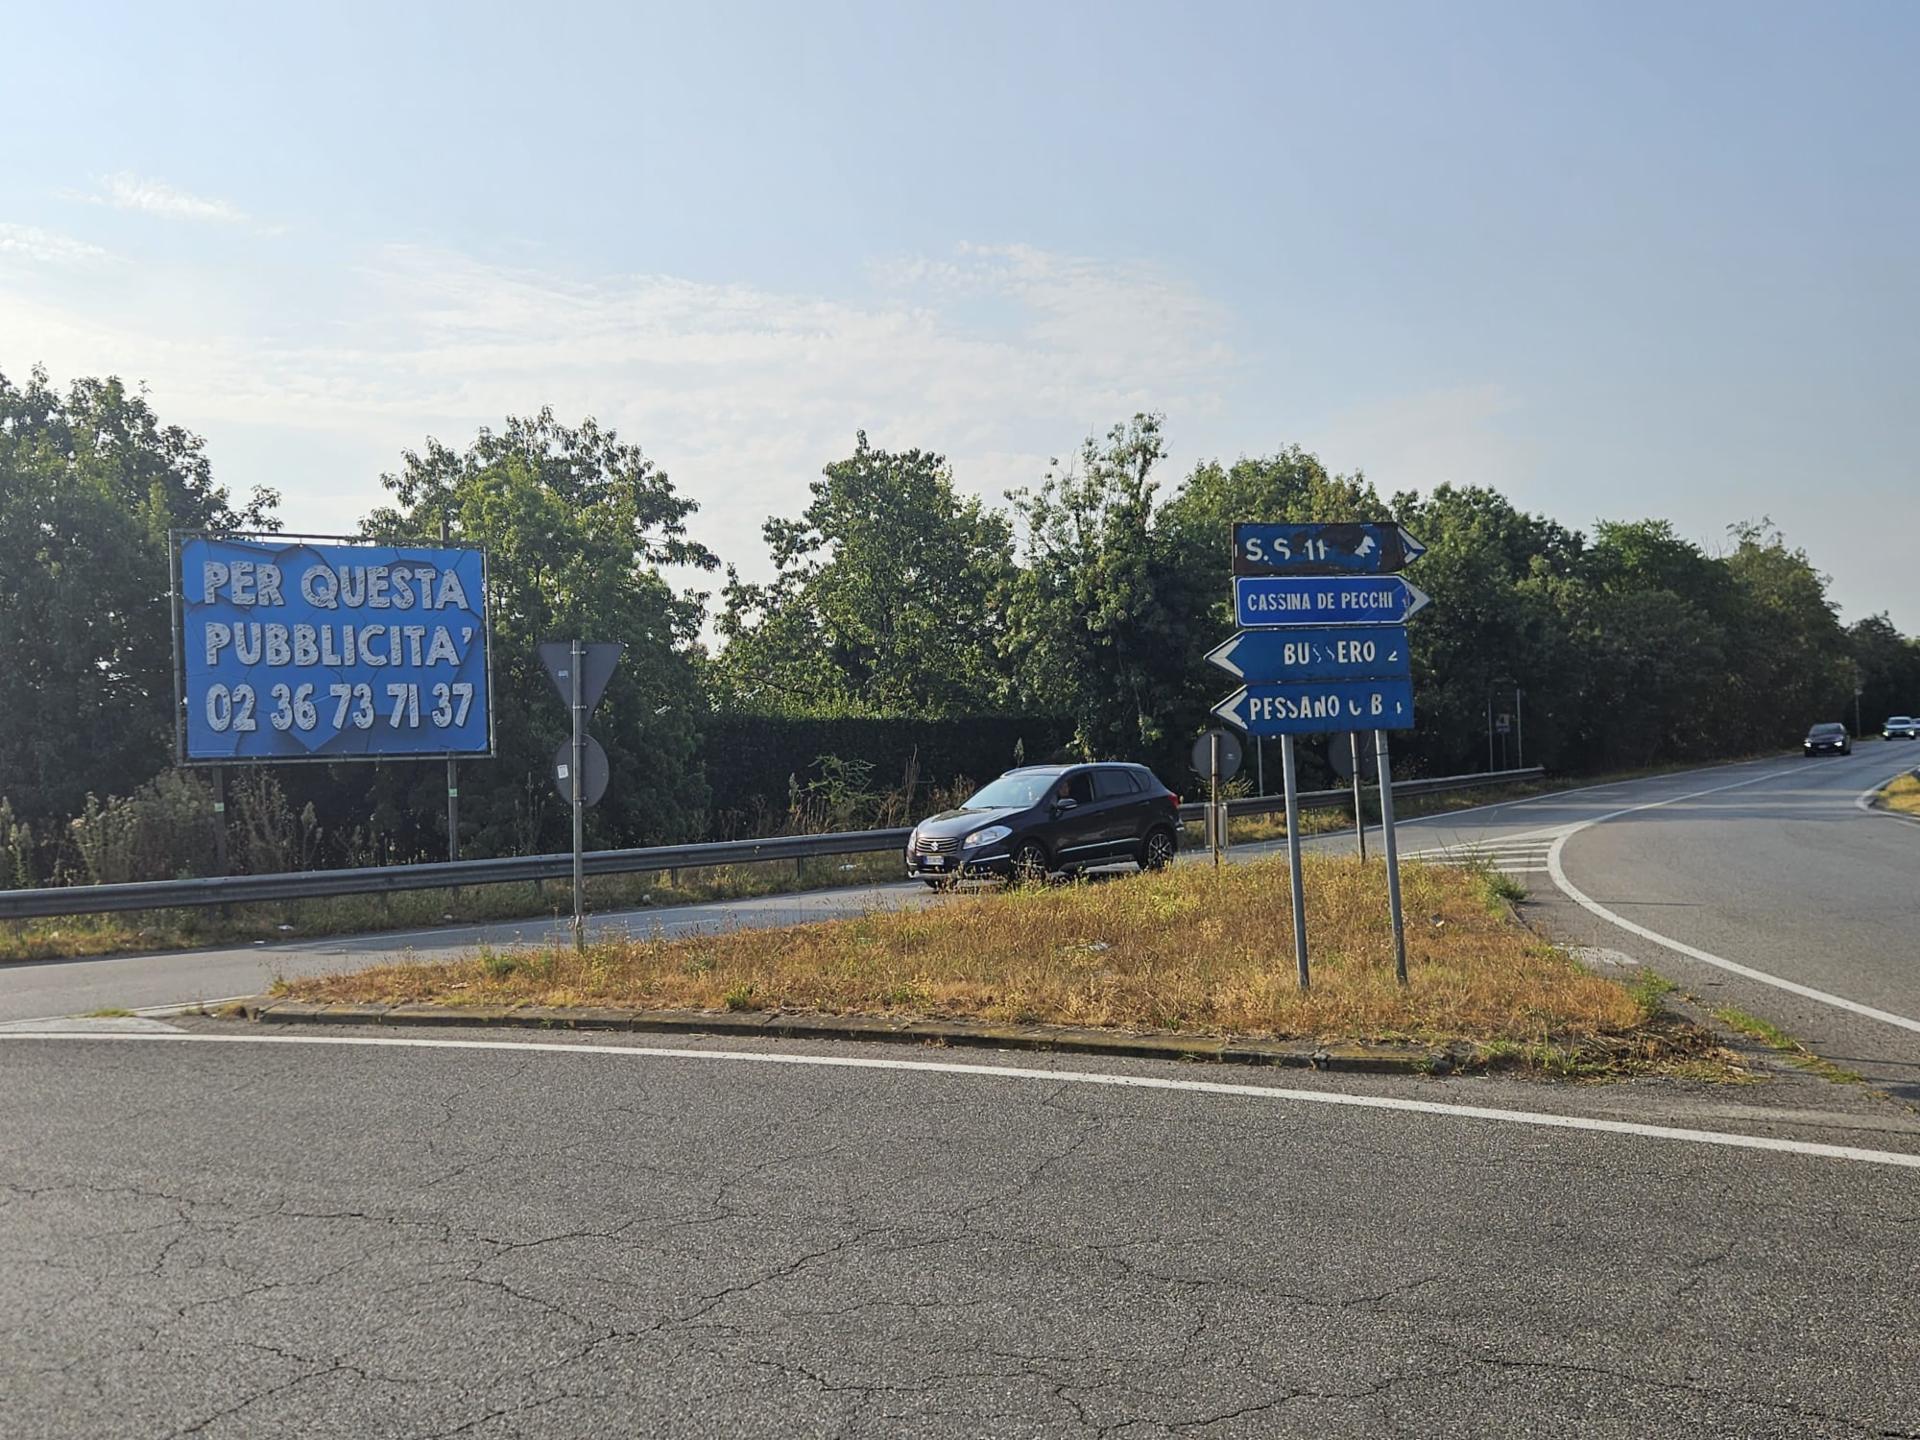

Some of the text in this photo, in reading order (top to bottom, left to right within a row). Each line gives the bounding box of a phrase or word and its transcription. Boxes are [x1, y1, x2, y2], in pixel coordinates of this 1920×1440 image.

[203, 561, 469, 610] PER QUESTA
[1247, 591, 1393, 611] CASSINA DE PECCHI
[205, 622, 472, 667] PUBBLICITA'
[206, 682, 473, 732] 02 36 73 71 37
[1250, 695, 1340, 720] PESSANO
